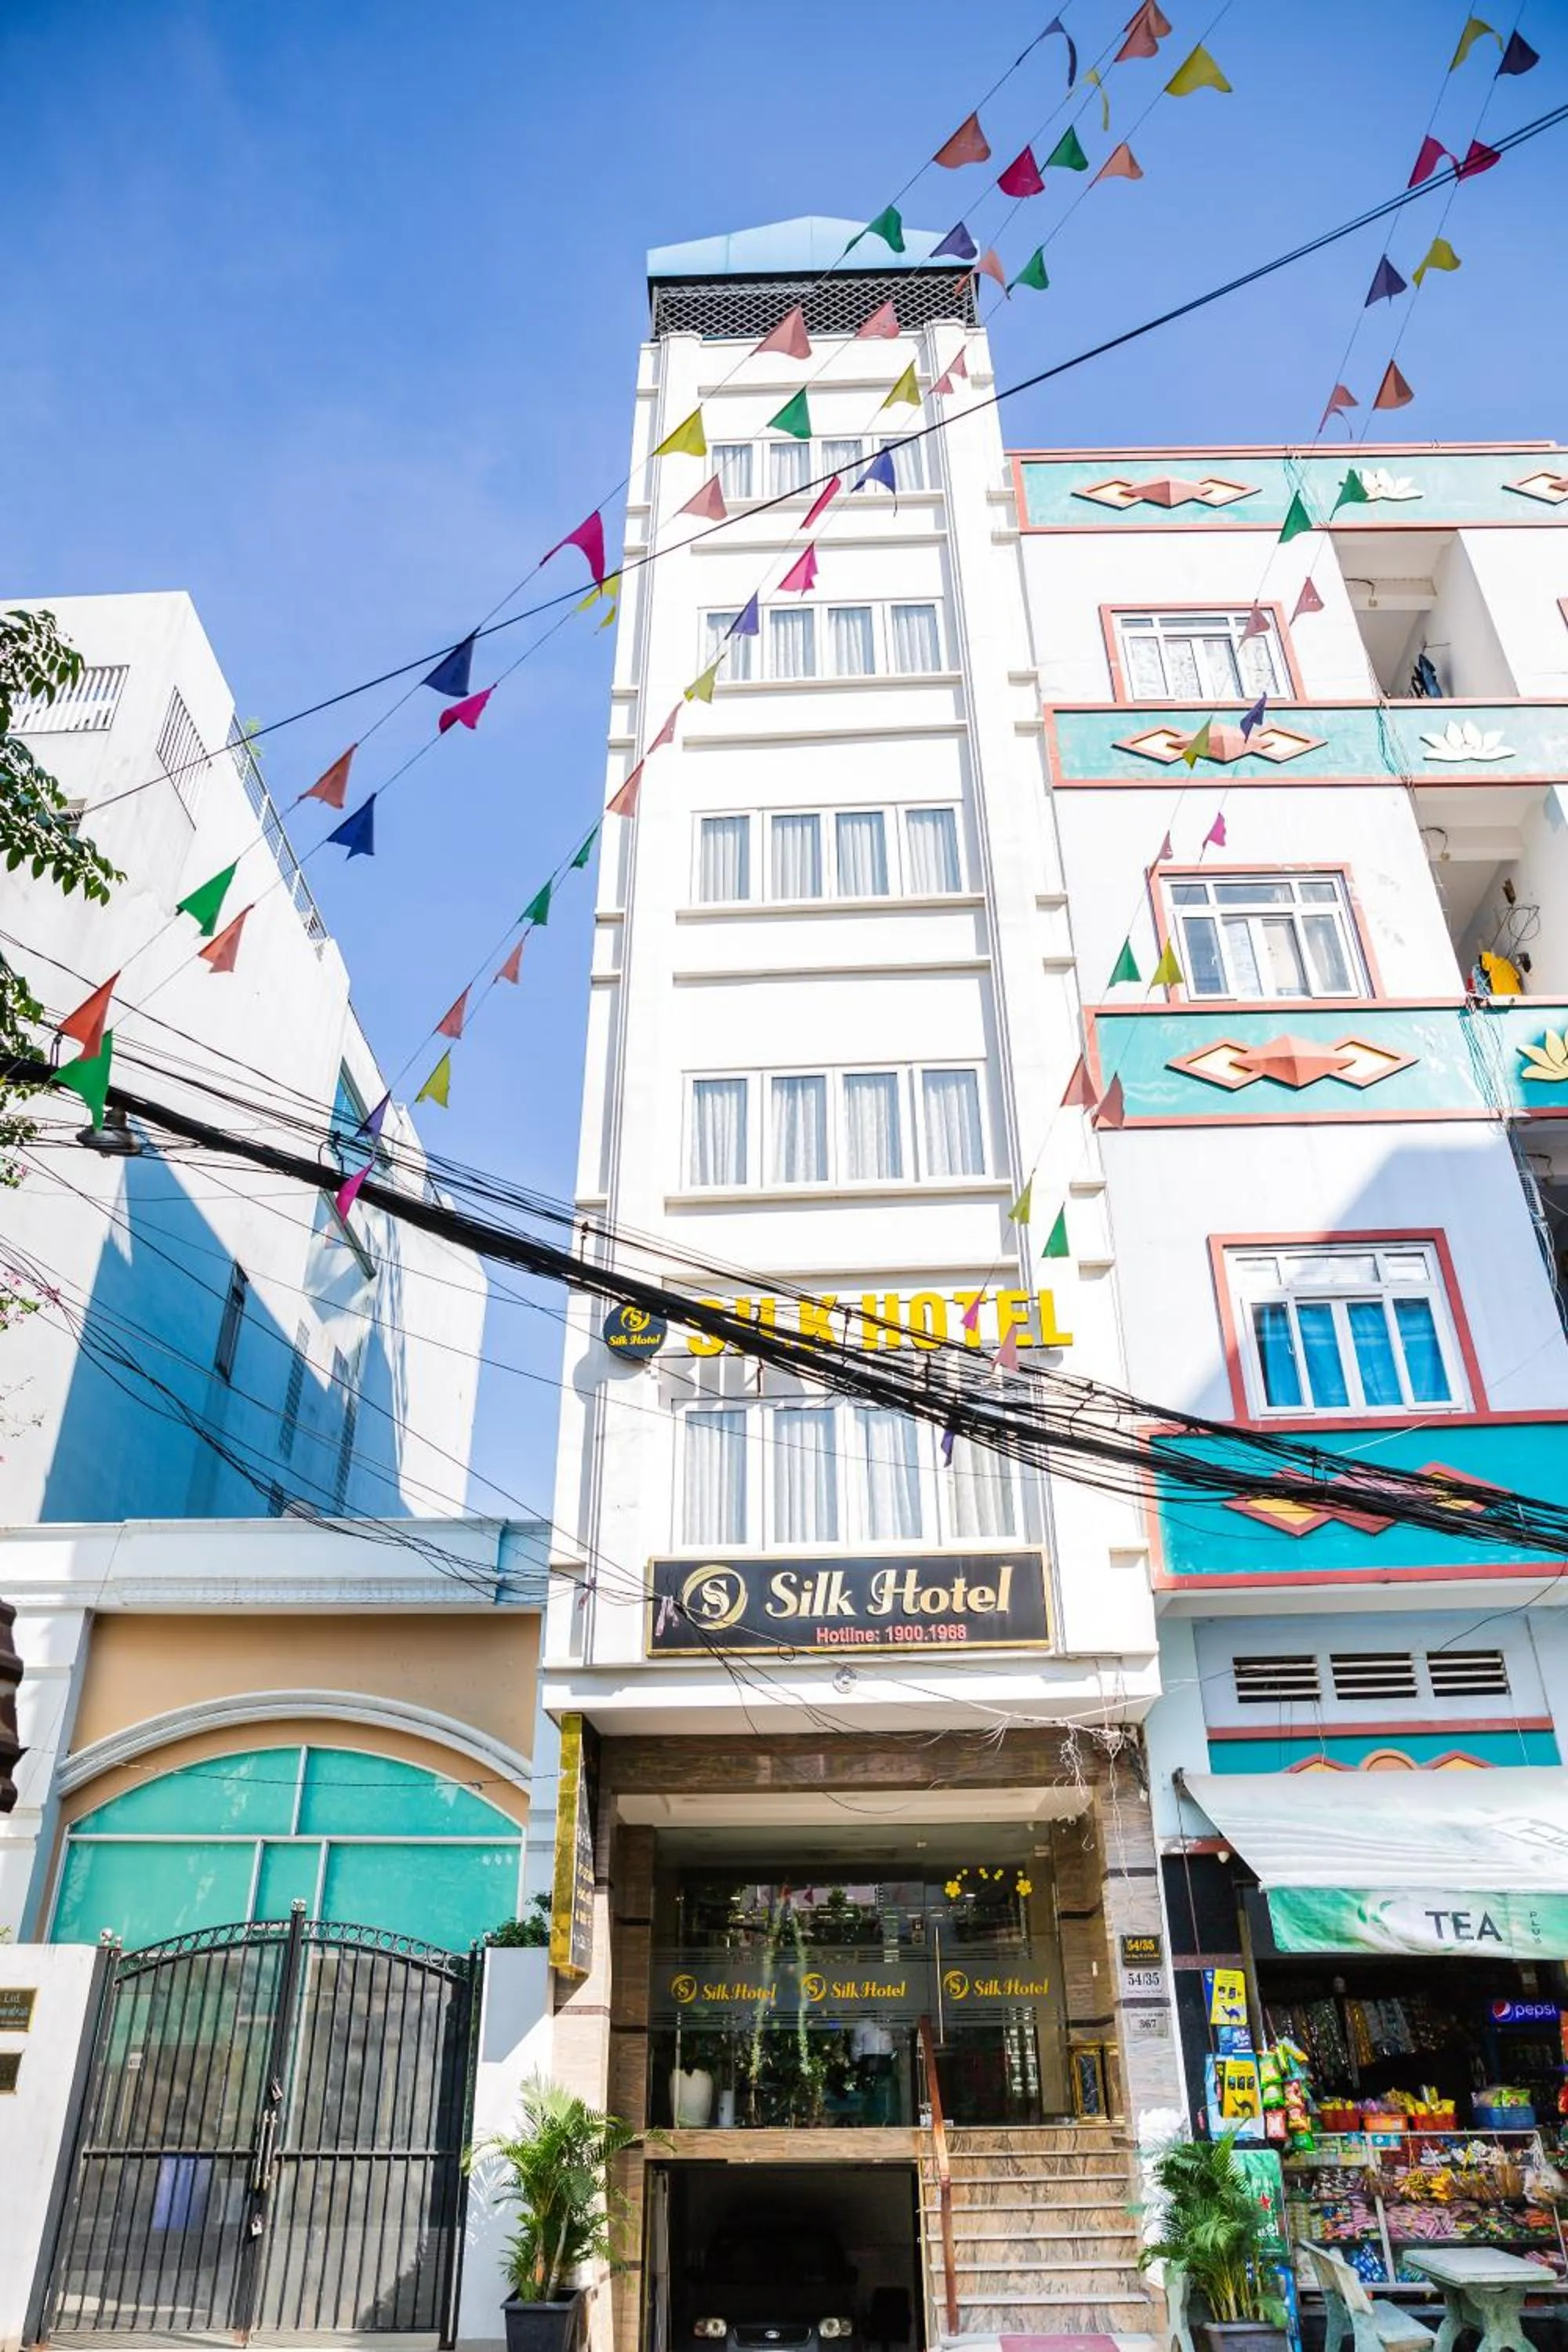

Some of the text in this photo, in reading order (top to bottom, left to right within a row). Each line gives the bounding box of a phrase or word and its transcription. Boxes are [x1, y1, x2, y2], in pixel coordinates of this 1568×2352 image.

[862, 1290, 1073, 1351] HOTEL
[609, 1334, 661, 1346] Silk Hotel
[765, 1566, 1014, 1618] Silk Hotel
[816, 1624, 967, 1644] Hotline: 1900.1968
[1425, 1911, 1503, 1942] TEA
[973, 1979, 1001, 1997] Silk
[1003, 1978, 1049, 1995] Hotel
[1127, 1971, 1160, 1987] 54/35
[702, 1983, 729, 2001] Silk
[730, 1982, 776, 2000] Hotel
[830, 1980, 859, 1999] Silk
[860, 1980, 906, 1998] Hotel
[1515, 2002, 1556, 2019] pepsi
